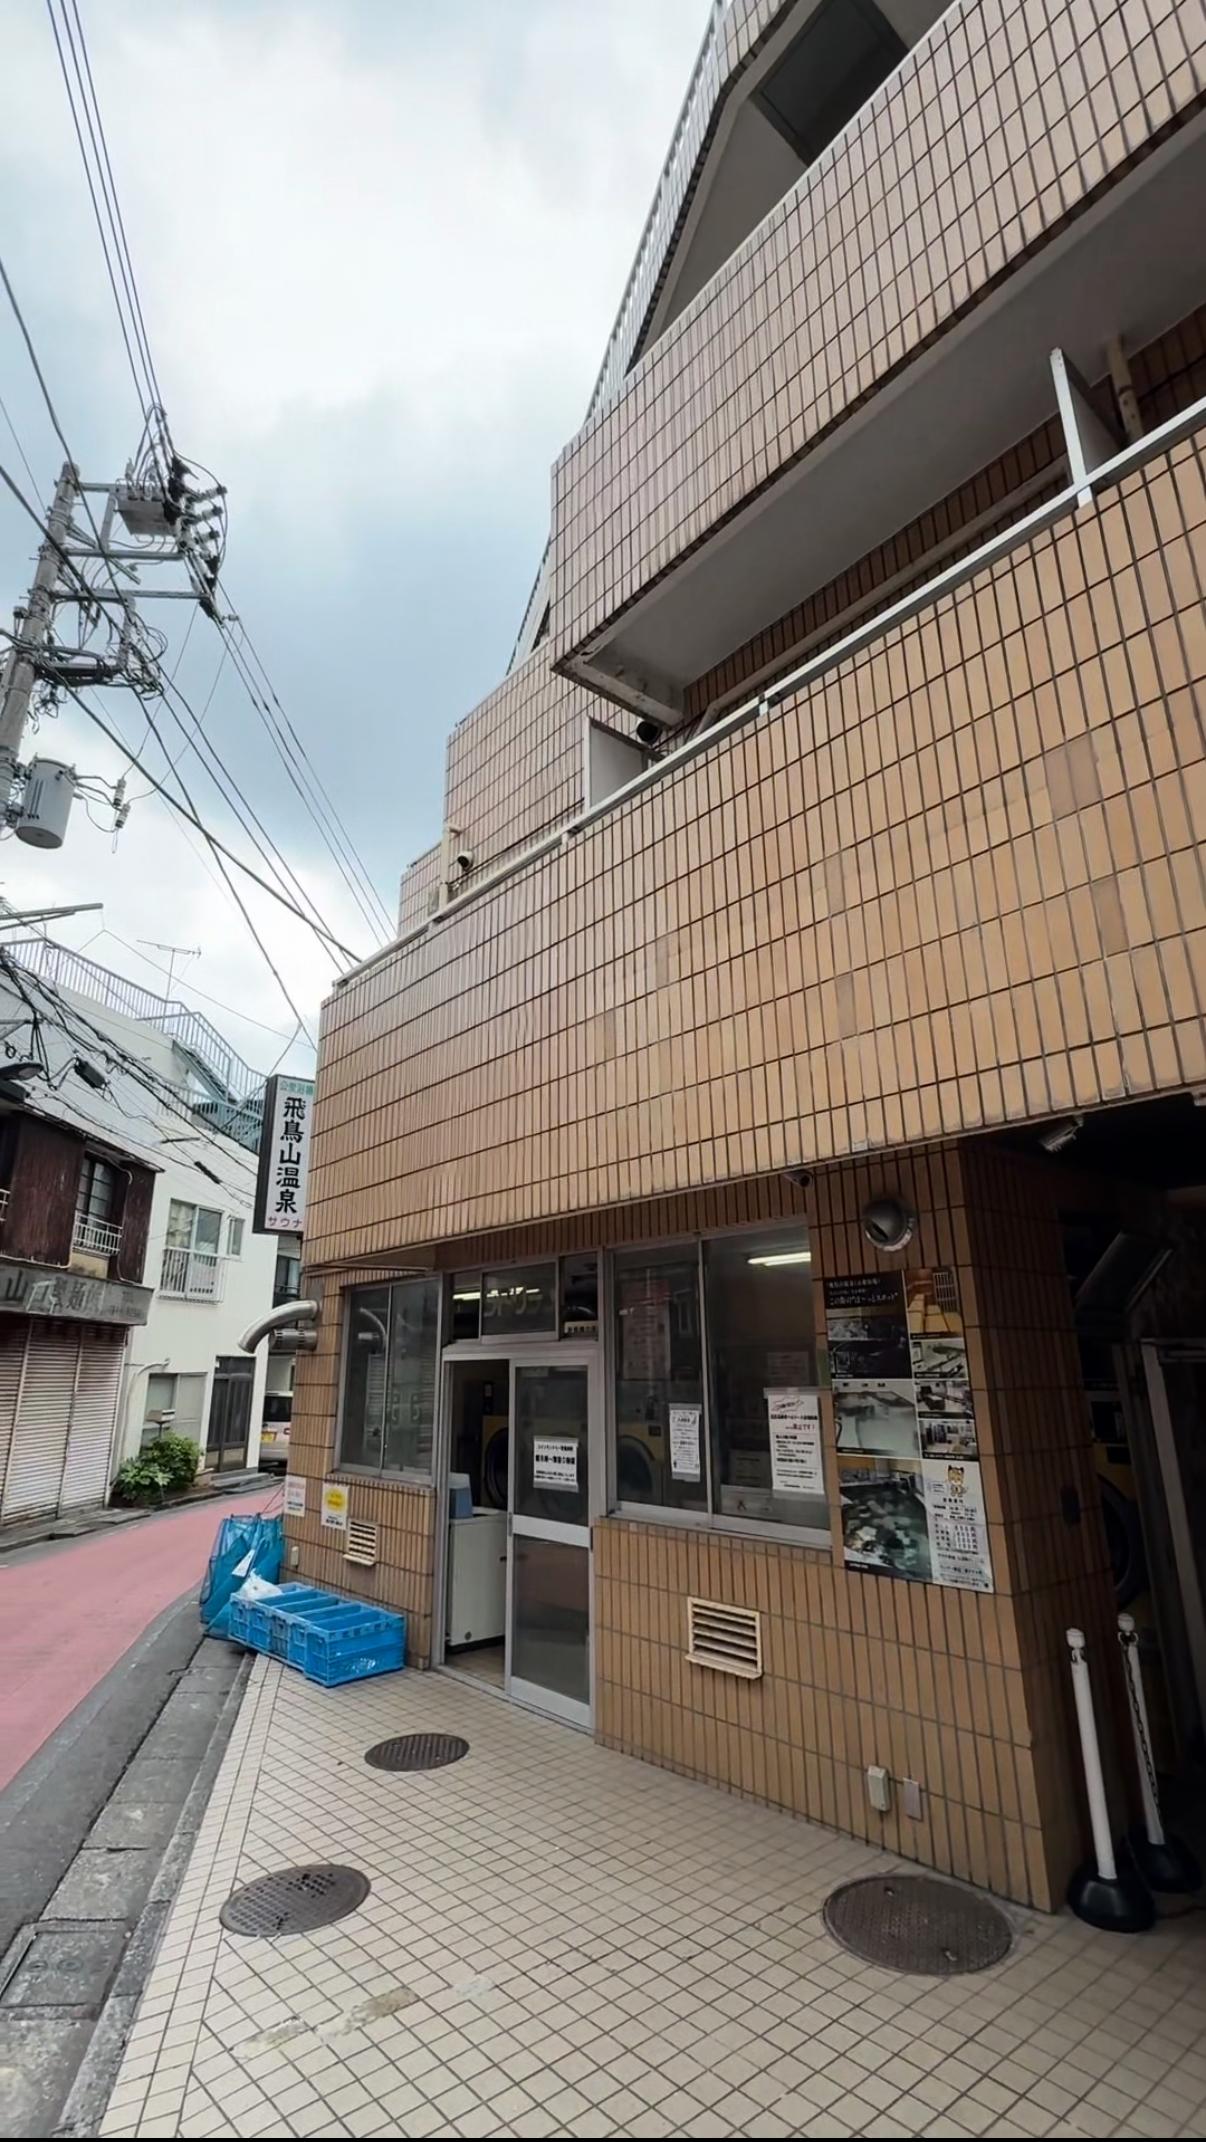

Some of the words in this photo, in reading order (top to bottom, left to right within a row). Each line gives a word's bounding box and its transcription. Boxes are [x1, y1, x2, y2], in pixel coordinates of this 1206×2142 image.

[275, 1096, 306, 1214] 飛鳥山温泉
[268, 1216, 303, 1228] サウナ
